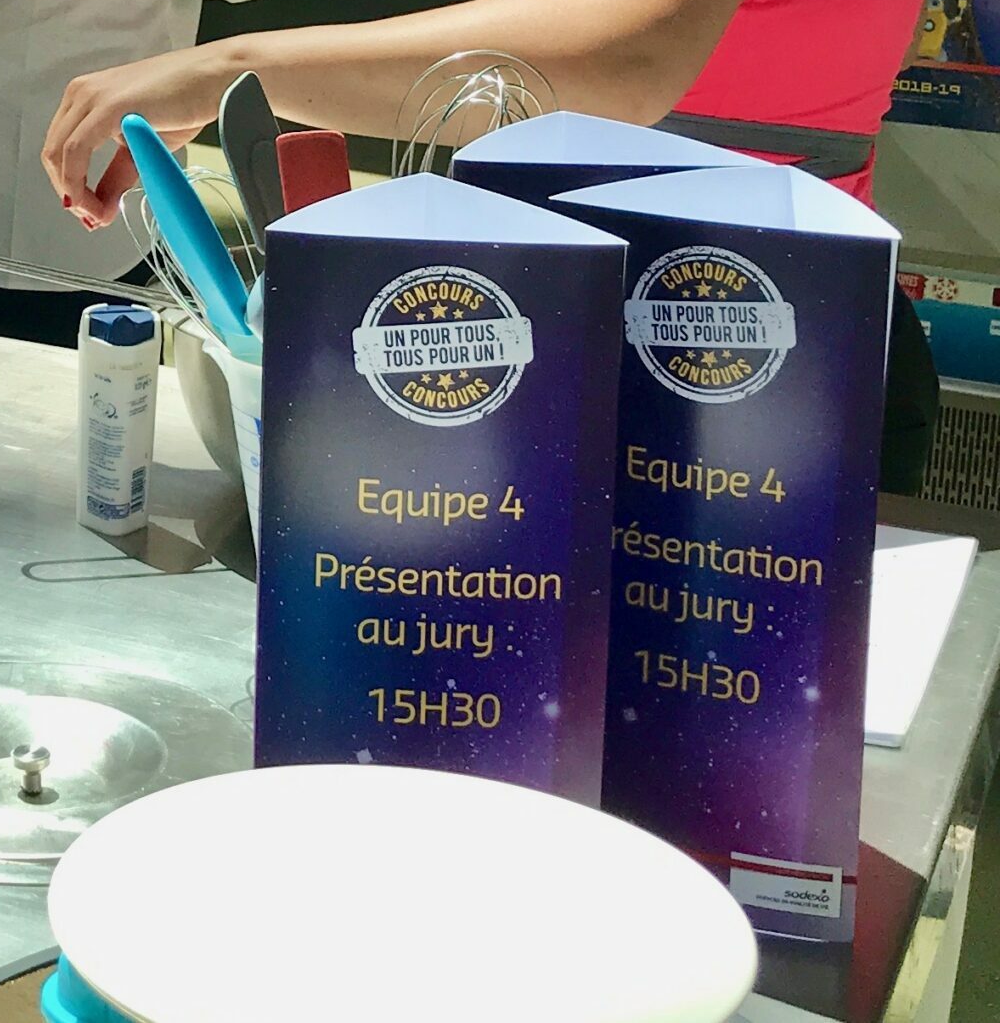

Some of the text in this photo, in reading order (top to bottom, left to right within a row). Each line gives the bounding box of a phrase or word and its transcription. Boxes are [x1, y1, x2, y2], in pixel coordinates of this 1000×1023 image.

[661, 261, 749, 293] CONCOURS
[392, 281, 485, 314] CONCOURS
[651, 304, 763, 325] UN POUR TOUS,
[384, 324, 500, 348] UN POUR TOUS,
[651, 323, 766, 343] TOUS POUR UN !
[383, 342, 505, 368] TOUS POUR UN !
[667, 355, 753, 386] CONCOURS
[401, 377, 491, 409] CONCOURS
[626, 444, 786, 504] Equipe 4
[356, 478, 526, 526] Equipe 4
[611, 520, 823, 586] résentation
[314, 552, 562, 600] Présentation
[625, 581, 668, 612] au
[675, 582, 754, 635] jury
[357, 616, 405, 647] au
[411, 612, 495, 659] jury
[633, 648, 760, 706] 15H30
[368, 687, 502, 729] 15H30
[784, 888, 830, 903] sodexo
